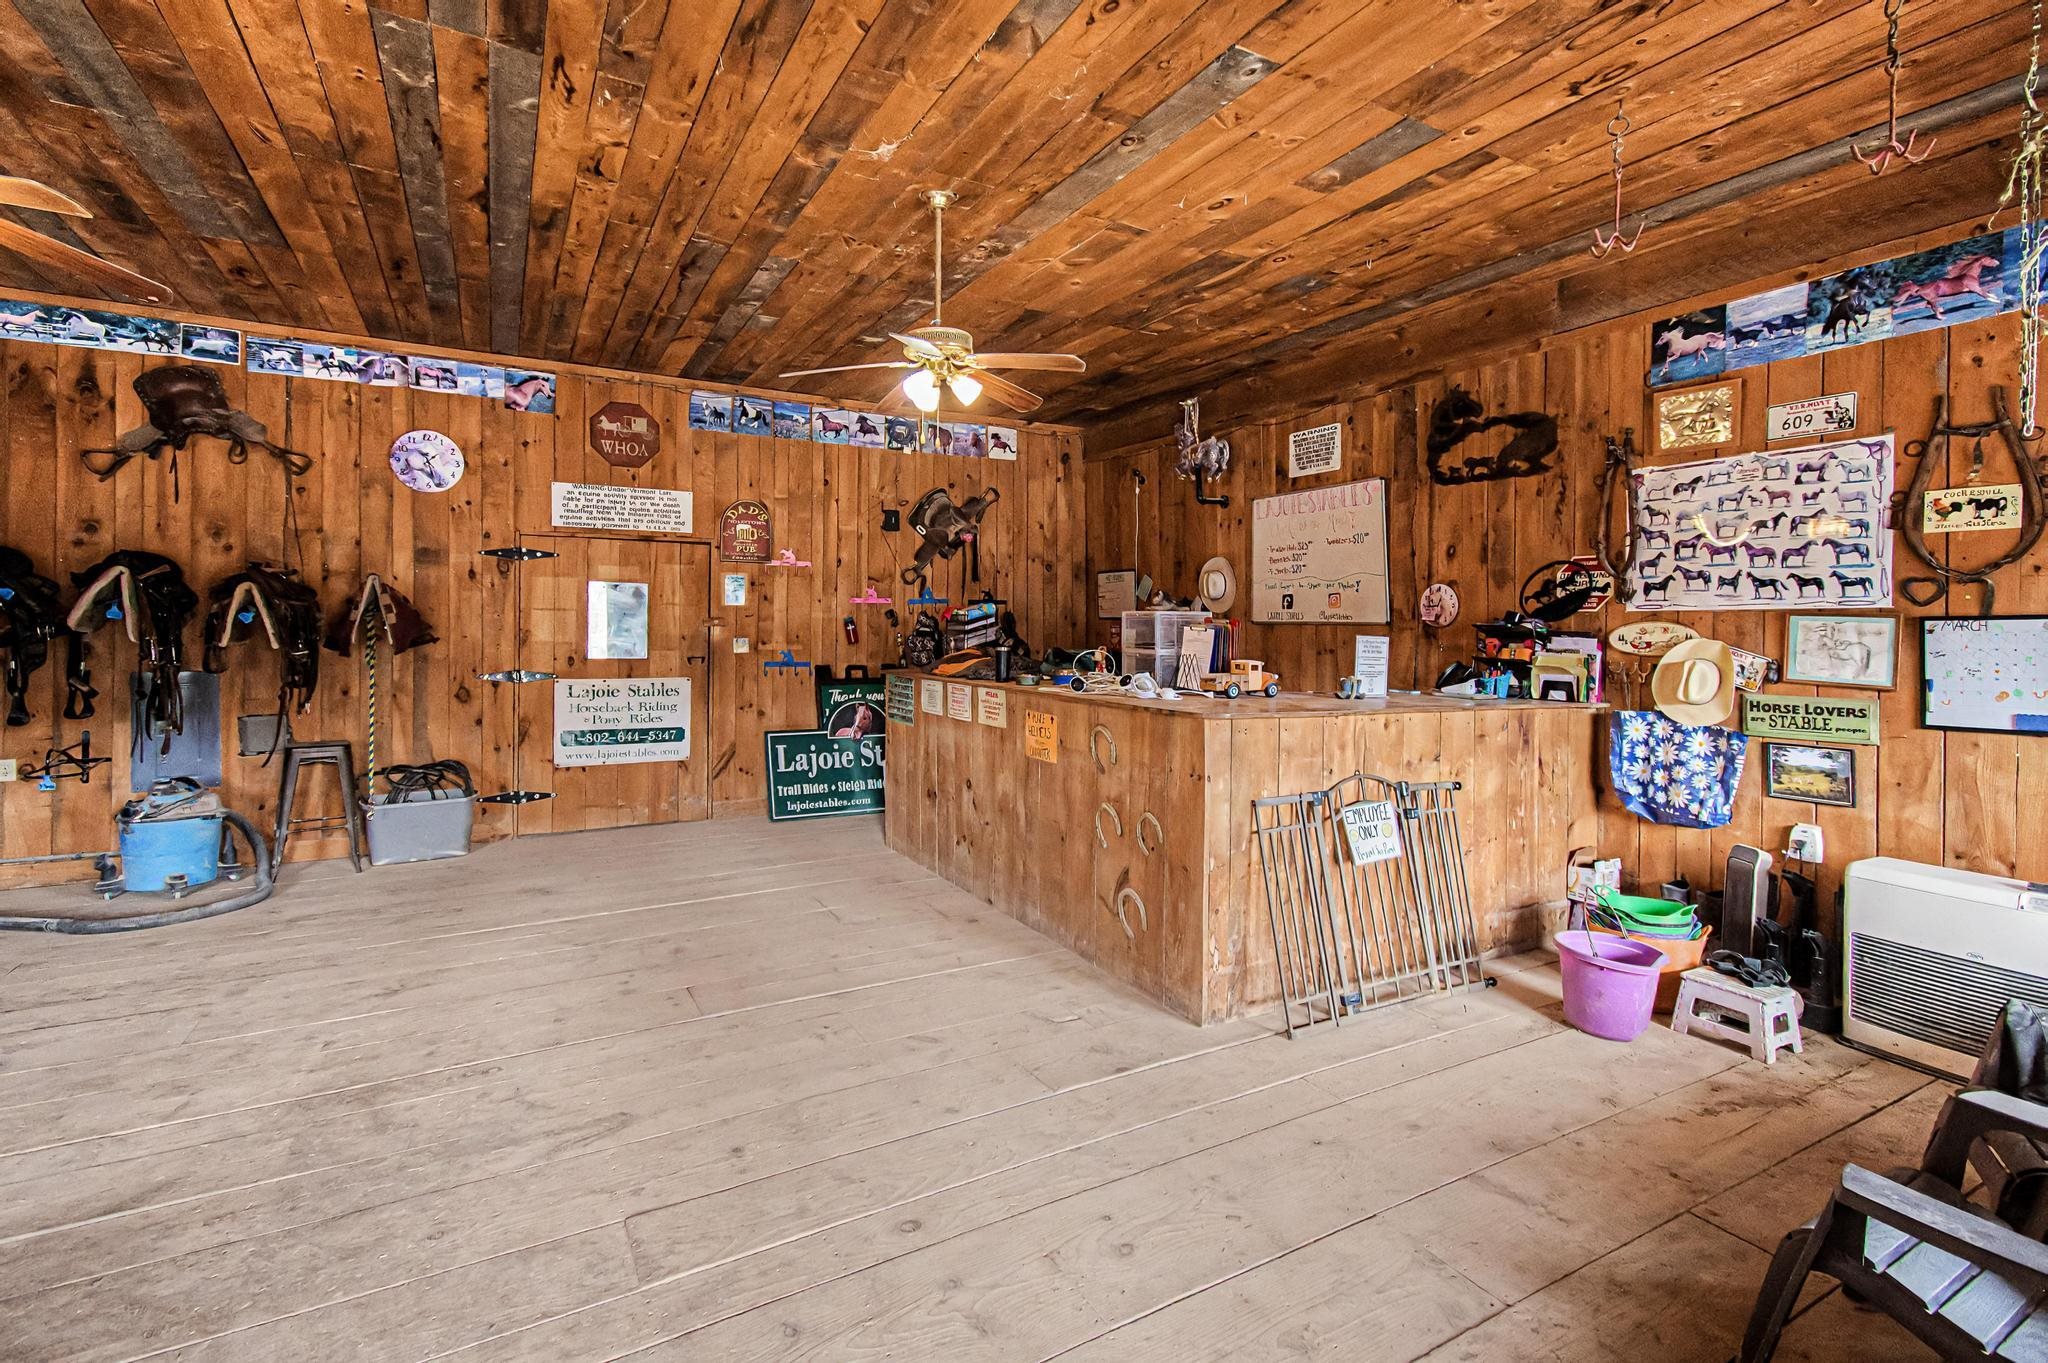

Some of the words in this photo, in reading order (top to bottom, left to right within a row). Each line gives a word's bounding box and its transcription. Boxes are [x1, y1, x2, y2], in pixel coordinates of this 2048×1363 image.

[1782, 414, 1813, 430] 609
[1293, 426, 1338, 438] WARNING
[601, 440, 648, 457] WHOA
[727, 505, 768, 522] DAD'S
[1941, 620, 1988, 632] MARCH
[567, 683, 620, 701] Lajoie
[628, 682, 680, 698] Stables
[829, 689, 862, 704] Thank
[569, 701, 634, 713] Horseback
[639, 701, 678, 713] Riding
[1749, 700, 1800, 715] HORSE
[1804, 703, 1868, 719] LOVERS
[592, 714, 623, 725] Pony
[630, 713, 664, 724] Rides
[1768, 714, 1833, 731] STABLE
[1835, 726, 1867, 734] people
[570, 730, 677, 743] 1-802-644-5347
[565, 748, 680, 761] www.lajoiestables.com
[775, 743, 855, 778] Lajoie
[860, 740, 886, 768] St
[777, 784, 801, 797] Trail
[803, 782, 829, 795] Rides
[837, 779, 866, 793] Sleigh
[787, 797, 871, 812] lajoiestables.com
[1344, 803, 1391, 825] EMPLOYEE
[1358, 824, 1379, 841] ONLY
